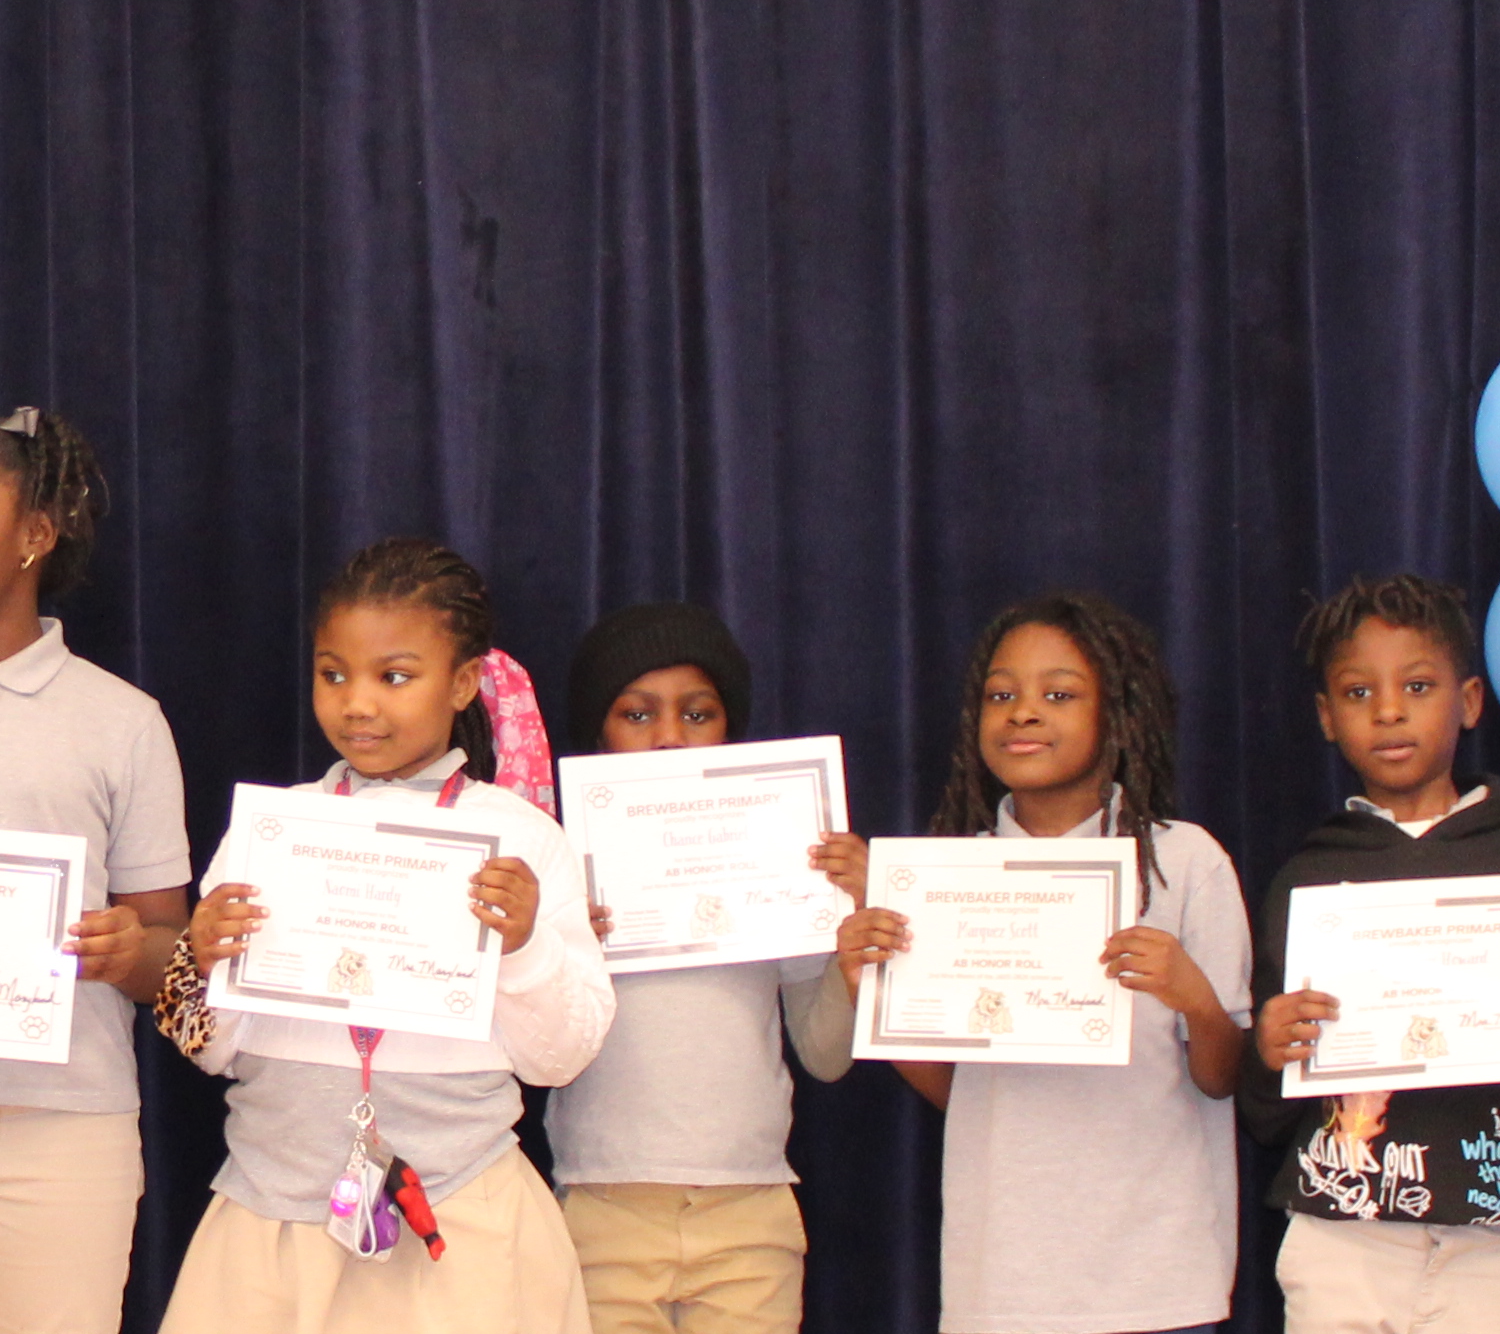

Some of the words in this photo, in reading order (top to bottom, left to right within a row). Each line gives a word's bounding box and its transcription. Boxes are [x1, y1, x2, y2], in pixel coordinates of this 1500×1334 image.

[627, 799, 715, 818] BREWBAKER
[719, 793, 782, 809] PRIMARY
[662, 831, 703, 848] Chance
[292, 844, 381, 865] BREWBAKER
[386, 854, 449, 873] PRIMARY
[684, 865, 724, 875] HONOR
[730, 861, 759, 870] ROLL
[324, 879, 360, 898] Naomi
[365, 883, 402, 908] Hardy
[926, 891, 1009, 904] BREWBAKER
[1015, 892, 1075, 904] PRIMARY
[315, 916, 331, 925] AB
[335, 919, 377, 932] HONOR
[380, 923, 410, 936] ROLL
[1009, 921, 1039, 940] Scott
[953, 958, 967, 967] AB
[971, 959, 1010, 968] HONOR
[1015, 959, 1043, 968] ROLL
